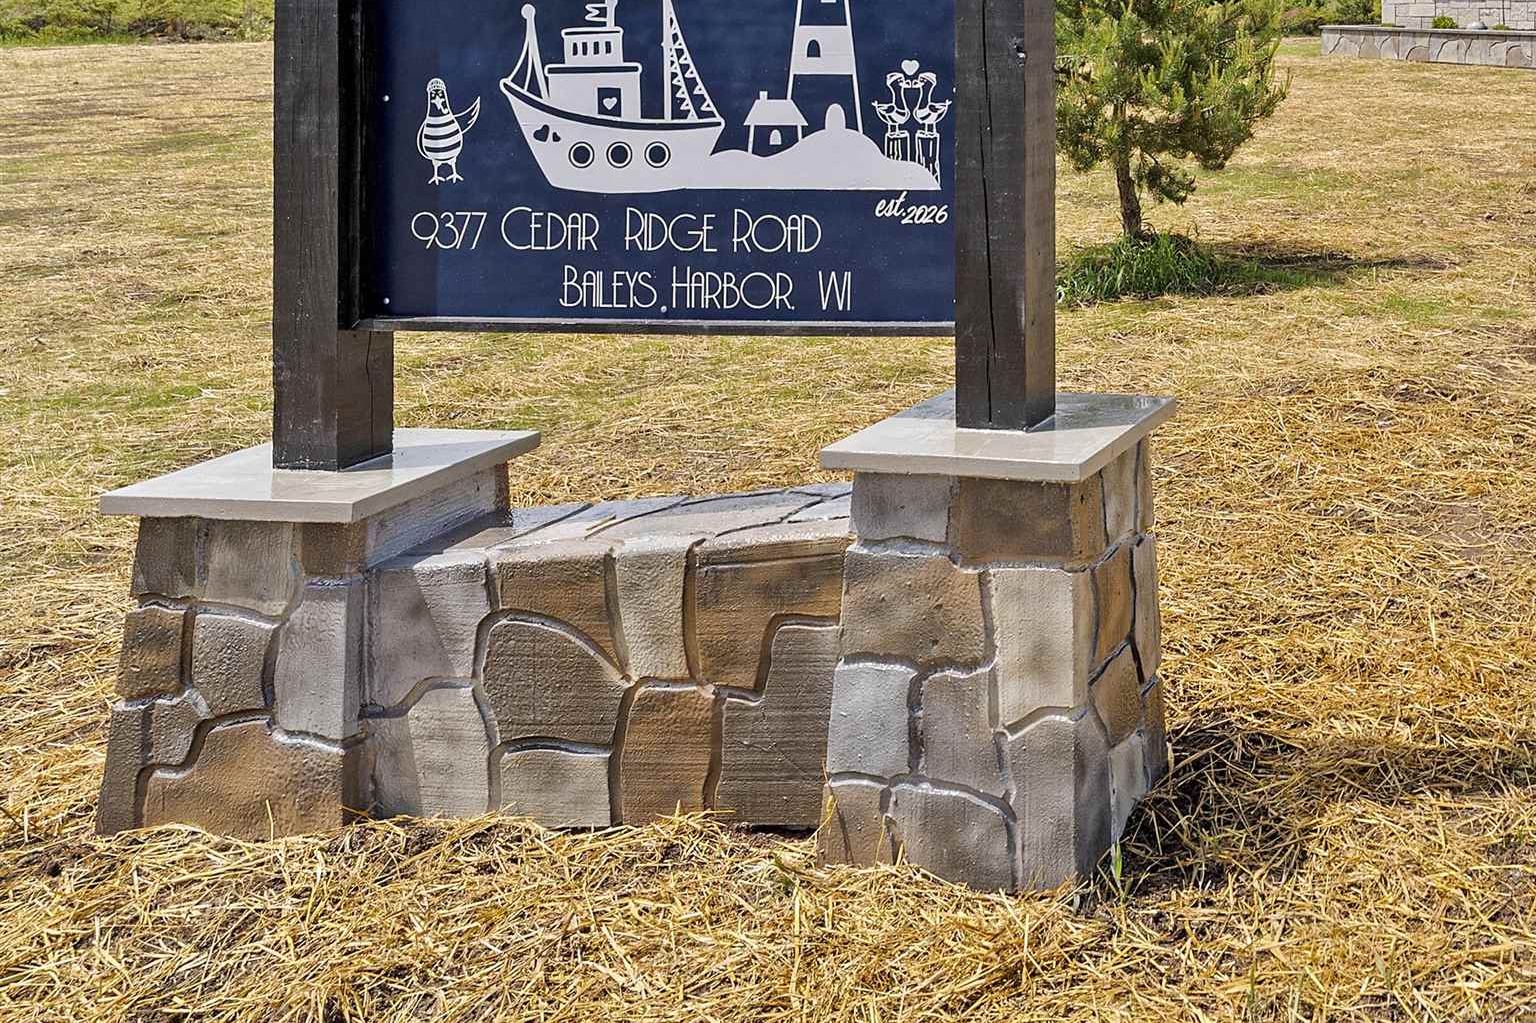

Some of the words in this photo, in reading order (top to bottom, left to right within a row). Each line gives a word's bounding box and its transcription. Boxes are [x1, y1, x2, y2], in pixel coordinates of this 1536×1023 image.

[875, 191, 906, 218] est.
[900, 205, 949, 225] 2026
[411, 211, 487, 250] 9377
[500, 208, 599, 251] CEDAR
[624, 207, 717, 253] RIDGE
[732, 209, 822, 253] ROAD
[819, 270, 852, 310] WI
